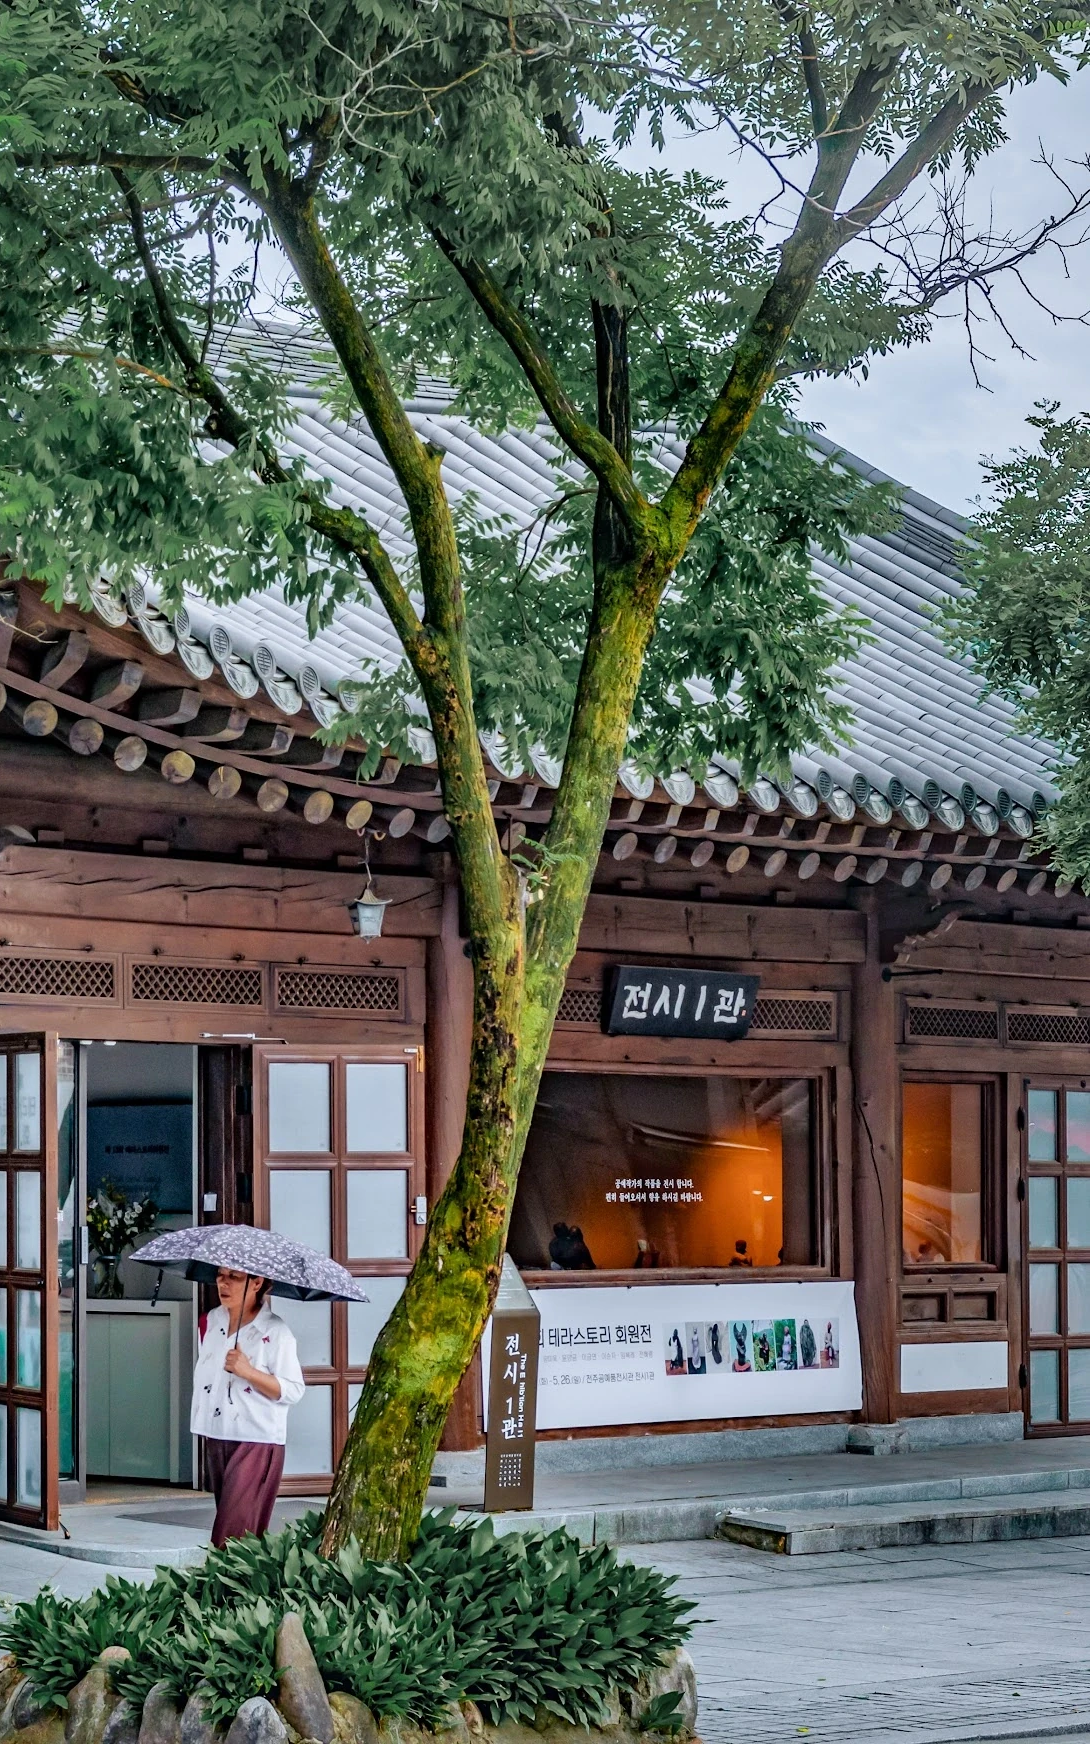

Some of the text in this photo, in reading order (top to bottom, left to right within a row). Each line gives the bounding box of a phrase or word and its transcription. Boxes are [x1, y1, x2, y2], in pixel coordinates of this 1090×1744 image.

[663, 1179, 675, 1189] 전시
[676, 1179, 695, 1189] 합니다.
[680, 1192, 704, 1202] 바랍니다.
[548, 1325, 612, 1348] 테라스토리
[614, 1323, 652, 1345] 회원전
[586, 1372, 634, 1384] 전주공예품전시관
